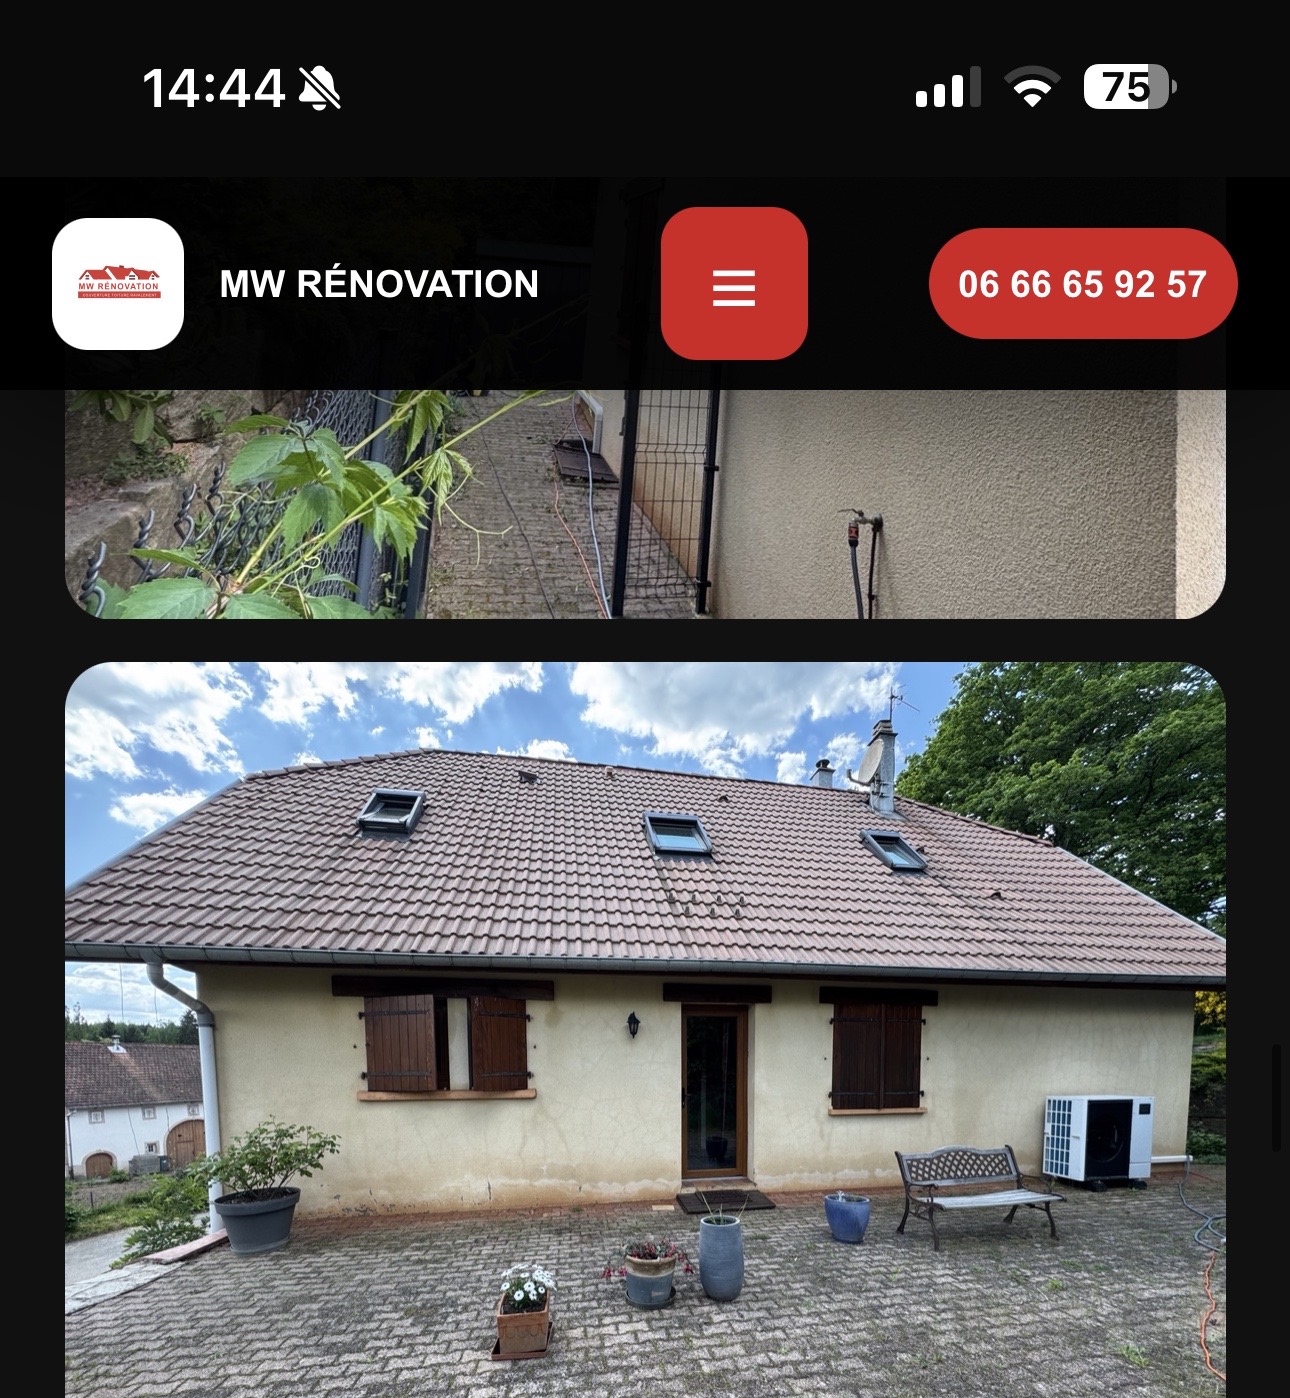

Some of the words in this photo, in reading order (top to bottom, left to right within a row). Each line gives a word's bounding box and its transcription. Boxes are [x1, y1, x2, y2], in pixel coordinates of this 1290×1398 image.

[143, 68, 286, 108] 14:44
[1102, 71, 1151, 102] 75
[98, 281, 159, 290] RÉNOVATION
[221, 269, 286, 298] MW
[298, 262, 538, 298] RÉNOVATION
[959, 269, 1000, 298] 06
[1011, 269, 1052, 298] 66
[1063, 269, 1104, 298] 65
[1114, 269, 1155, 299] 92
[1167, 269, 1207, 299] 57
